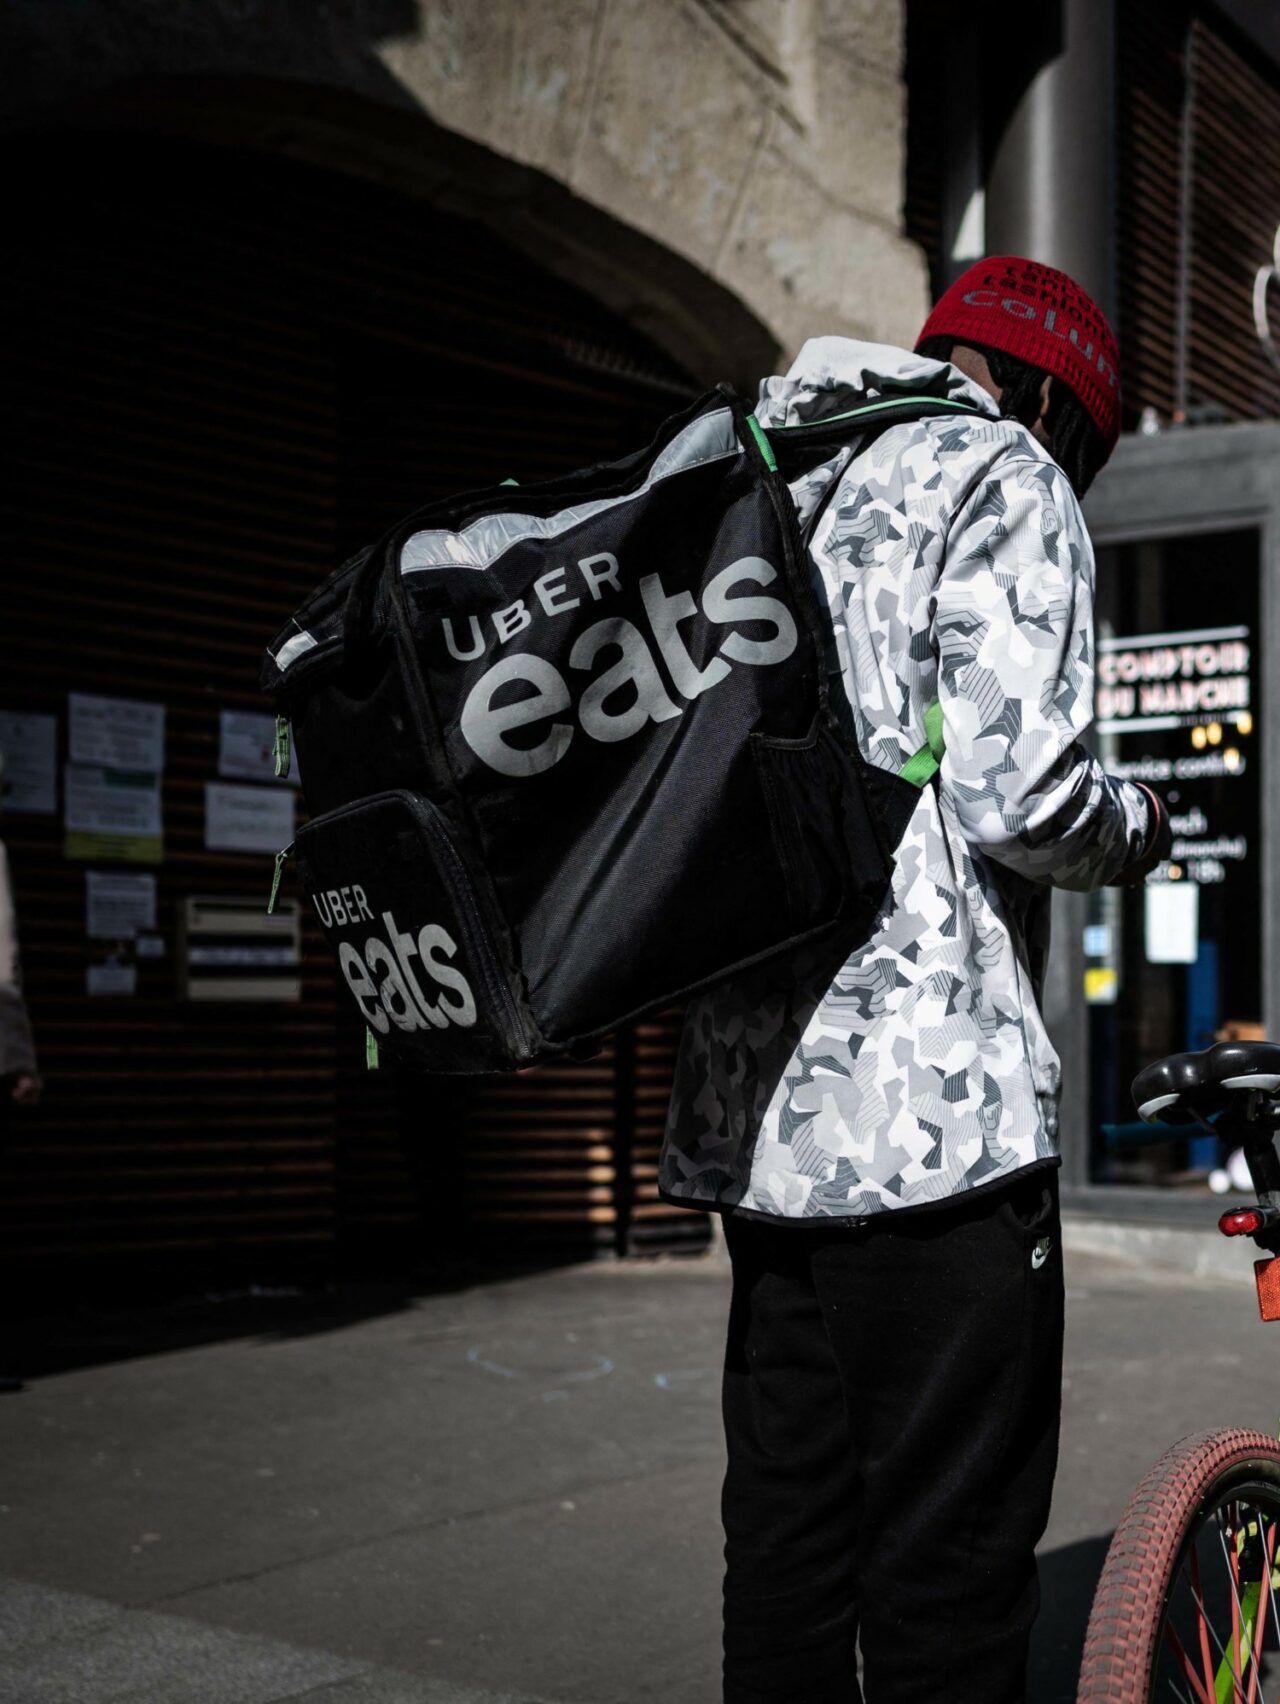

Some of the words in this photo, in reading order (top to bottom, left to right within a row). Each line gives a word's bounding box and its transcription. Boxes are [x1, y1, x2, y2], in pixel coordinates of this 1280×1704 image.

[441, 551, 624, 662] UBER
[460, 556, 799, 778] eats
[1098, 641, 1250, 685] COMPTOIR
[1097, 687, 1136, 719] DU
[1104, 756, 1173, 783] ervice
[312, 883, 376, 929] UBER
[338, 910, 478, 1035] eats
